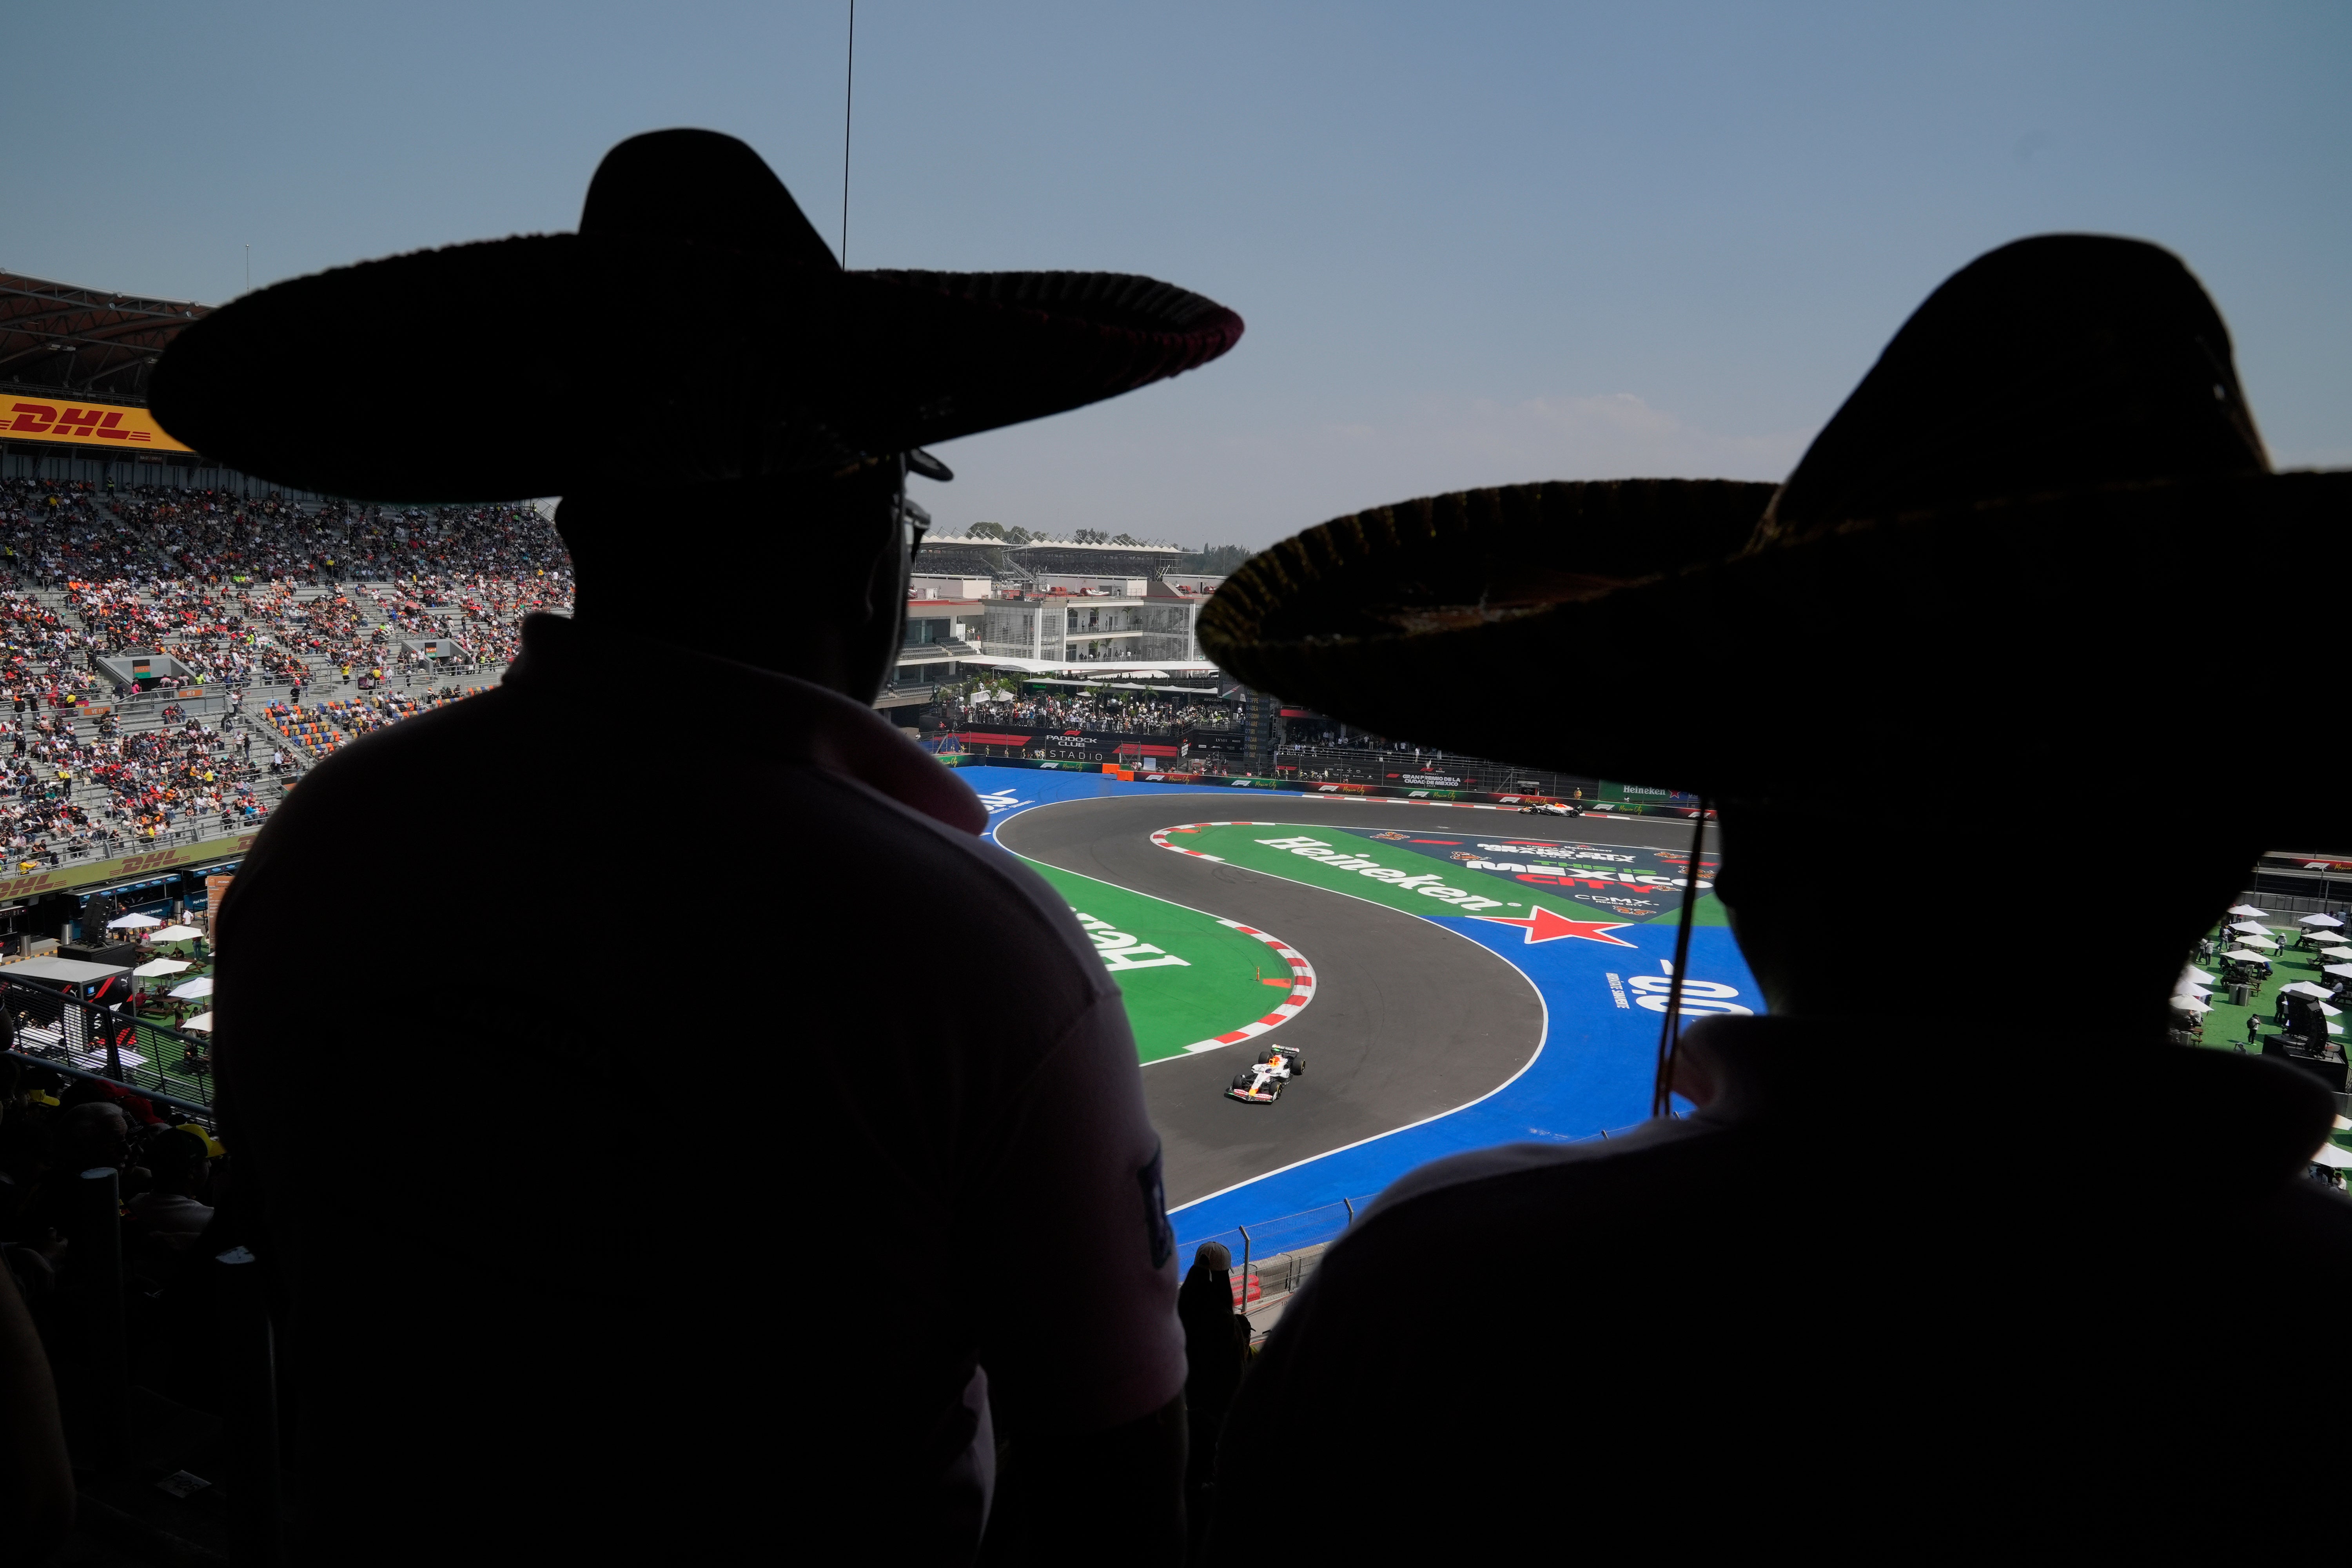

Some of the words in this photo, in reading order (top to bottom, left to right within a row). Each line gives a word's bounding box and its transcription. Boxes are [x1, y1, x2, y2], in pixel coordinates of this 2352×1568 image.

[10, 403, 131, 439] DHL
[1046, 735, 1098, 743] PADDOCK
[1050, 750, 1103, 760] STADIO
[1357, 785, 1365, 795] City
[1448, 791, 1457, 801] City
[1623, 785, 1666, 795] Heineken
[1634, 806, 1643, 815] City
[1477, 844, 1575, 855] MEXICO
[1579, 852, 1636, 861] CITY
[122, 849, 180, 873] DHL
[1533, 860, 1617, 872] THIS
[1254, 836, 1503, 911] Heineken
[1466, 861, 1713, 888] MEXICO
[1515, 874, 1658, 893] CITY
